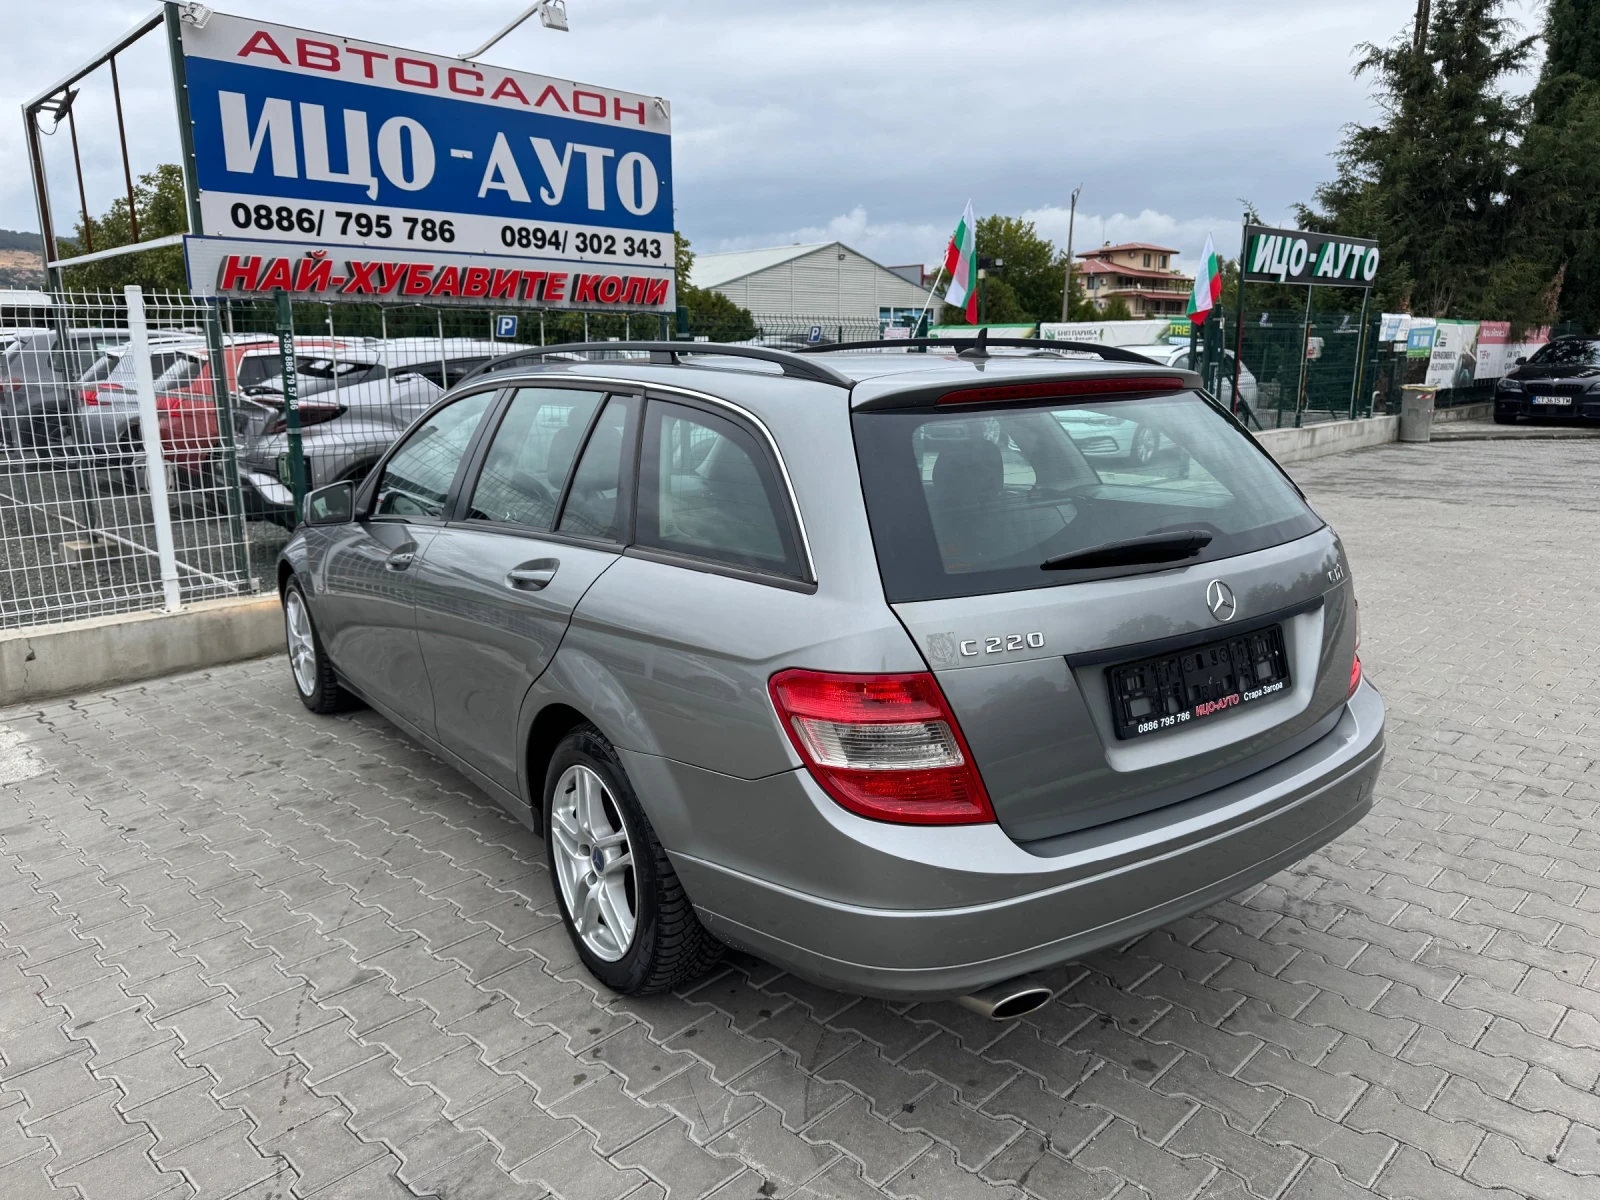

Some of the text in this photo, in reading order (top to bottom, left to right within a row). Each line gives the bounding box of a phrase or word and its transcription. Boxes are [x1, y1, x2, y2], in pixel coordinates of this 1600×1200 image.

[237, 30, 647, 126] АВТОСАЛОН
[335, 210, 393, 239] 795
[402, 216, 456, 243] 786
[574, 231, 617, 256] 302
[623, 235, 662, 259] 343
[219, 248, 670, 306] НАЙ-ХУБАВИТЕ КОЛИ
[283, 332, 299, 410] +359 886 79 57 86
[960, 631, 1046, 657] C 220
[1137, 682, 1283, 734] 0886 795 786 ИЦО-АУТО Стара Загора
